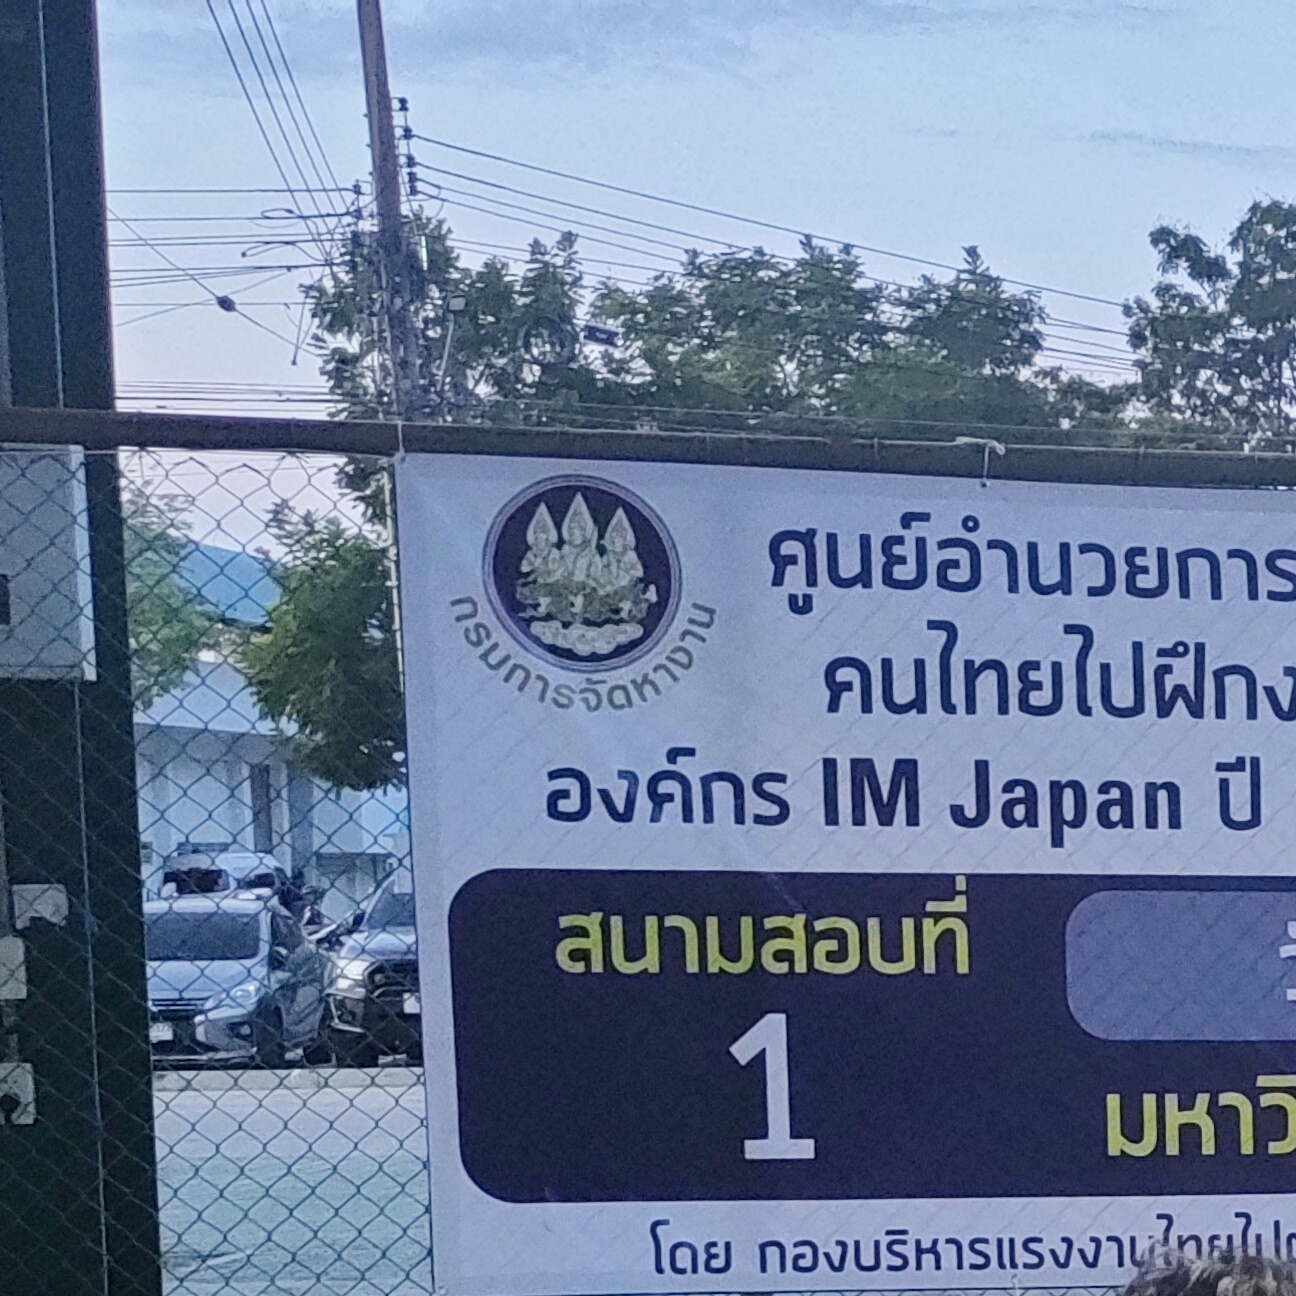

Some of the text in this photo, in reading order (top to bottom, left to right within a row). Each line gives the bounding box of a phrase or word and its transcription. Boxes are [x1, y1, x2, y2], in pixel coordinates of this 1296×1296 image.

[450, 596, 717, 712] กรมการจัดหางาน
[546, 747, 791, 827] องค์กร
[822, 757, 920, 828] IM
[949, 759, 1182, 849] Japan
[1214, 756, 1262, 832] ปี
[556, 876, 970, 975] สนามสอบที่
[729, 1012, 816, 1161] 1
[650, 1219, 732, 1275] โดย
